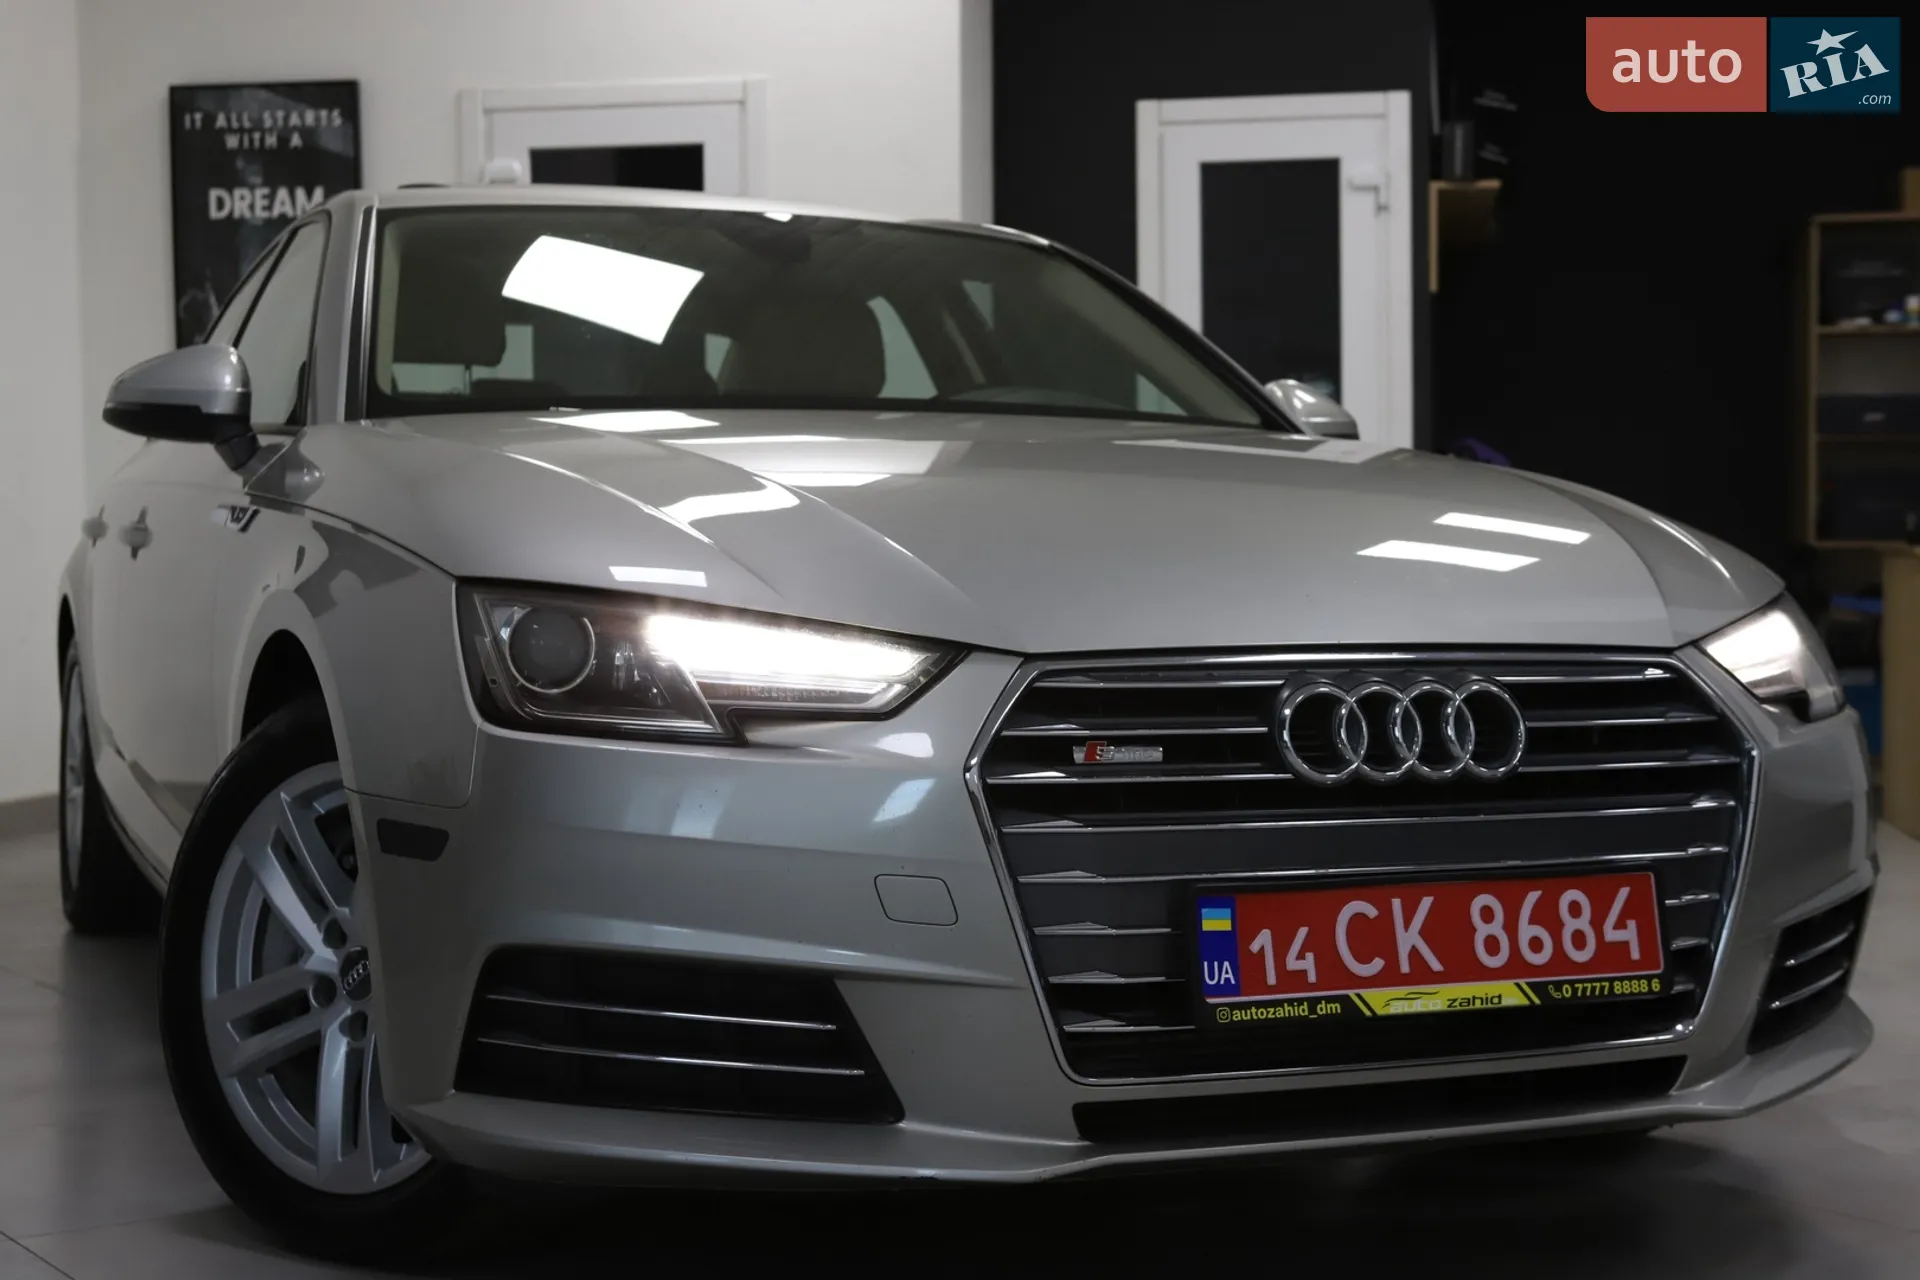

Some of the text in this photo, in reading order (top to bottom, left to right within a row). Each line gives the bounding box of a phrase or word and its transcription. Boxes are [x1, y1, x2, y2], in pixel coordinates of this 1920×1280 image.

[184, 108, 344, 131] IT ALL STARTS
[223, 131, 304, 150] WITH A
[1249, 885, 1641, 987] 14 CK 8684
[1203, 960, 1236, 985] UA
[1562, 977, 1661, 998] 0 7777 8888 6
[1231, 1000, 1342, 1022] autozahid_dm
[1446, 992, 1503, 1009] zahid
